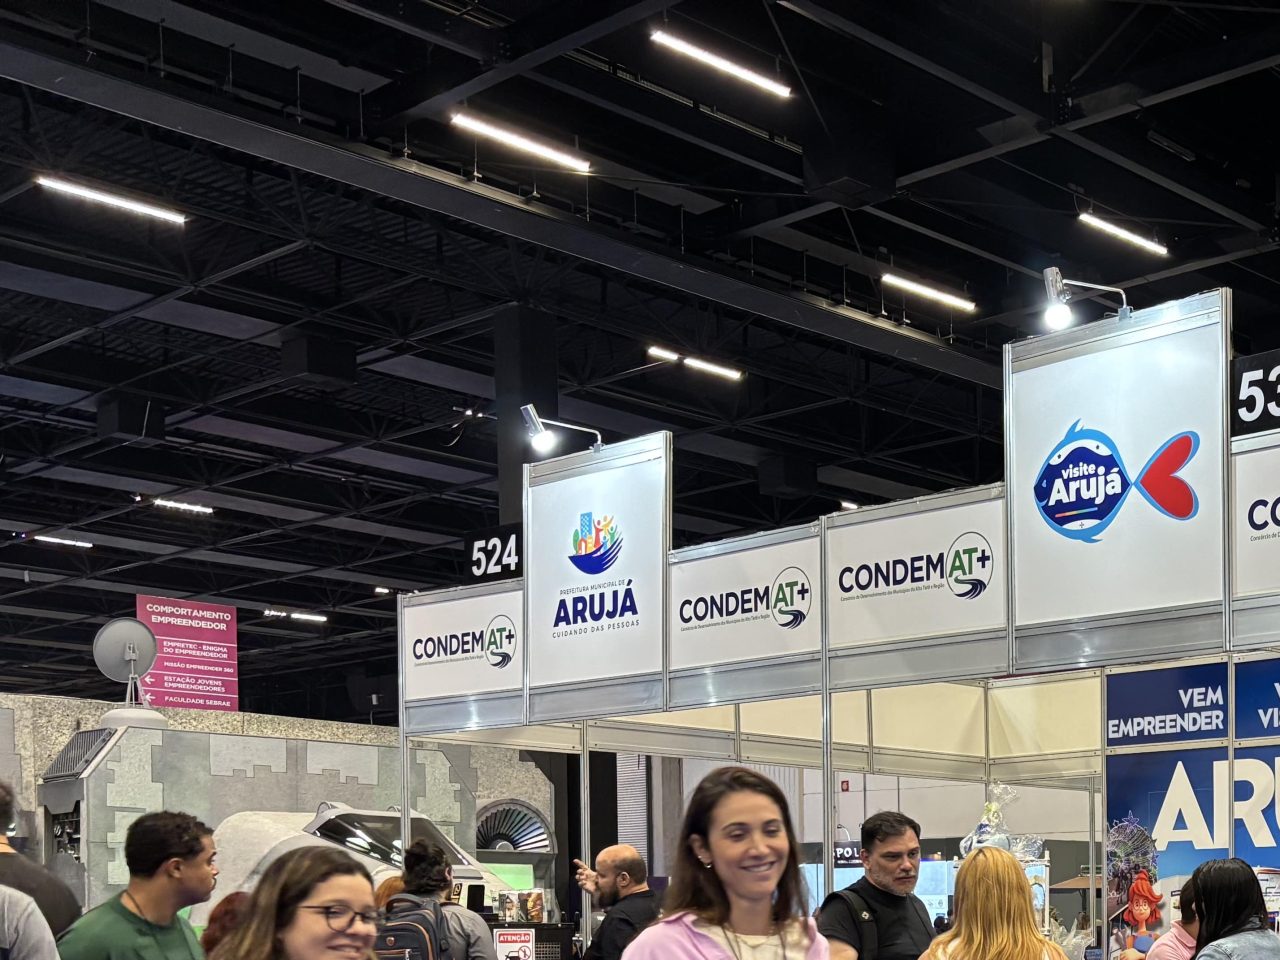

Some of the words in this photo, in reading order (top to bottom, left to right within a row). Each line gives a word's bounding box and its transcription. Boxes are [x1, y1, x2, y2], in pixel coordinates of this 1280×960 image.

[1061, 462, 1096, 480] visite
[1048, 466, 1122, 506] Arujá
[471, 534, 519, 577] 524
[559, 585, 589, 596] PREFEITURA
[590, 581, 617, 591] MUNICIPAL
[618, 579, 625, 587] DE
[146, 603, 231, 621] COMPORTAMENTO
[553, 578, 639, 628] ARUJÁ
[151, 615, 227, 631] EMPREENDEDOR
[552, 628, 588, 639] CUIDANDO
[591, 624, 604, 633] DAS
[607, 619, 640, 630] PESSOAS
[203, 645, 228, 653] ENIGMA
[1178, 685, 1224, 710] VEM
[1108, 709, 1224, 740] EMPREENDER
[499, 933, 530, 942] ATENÇÃO
